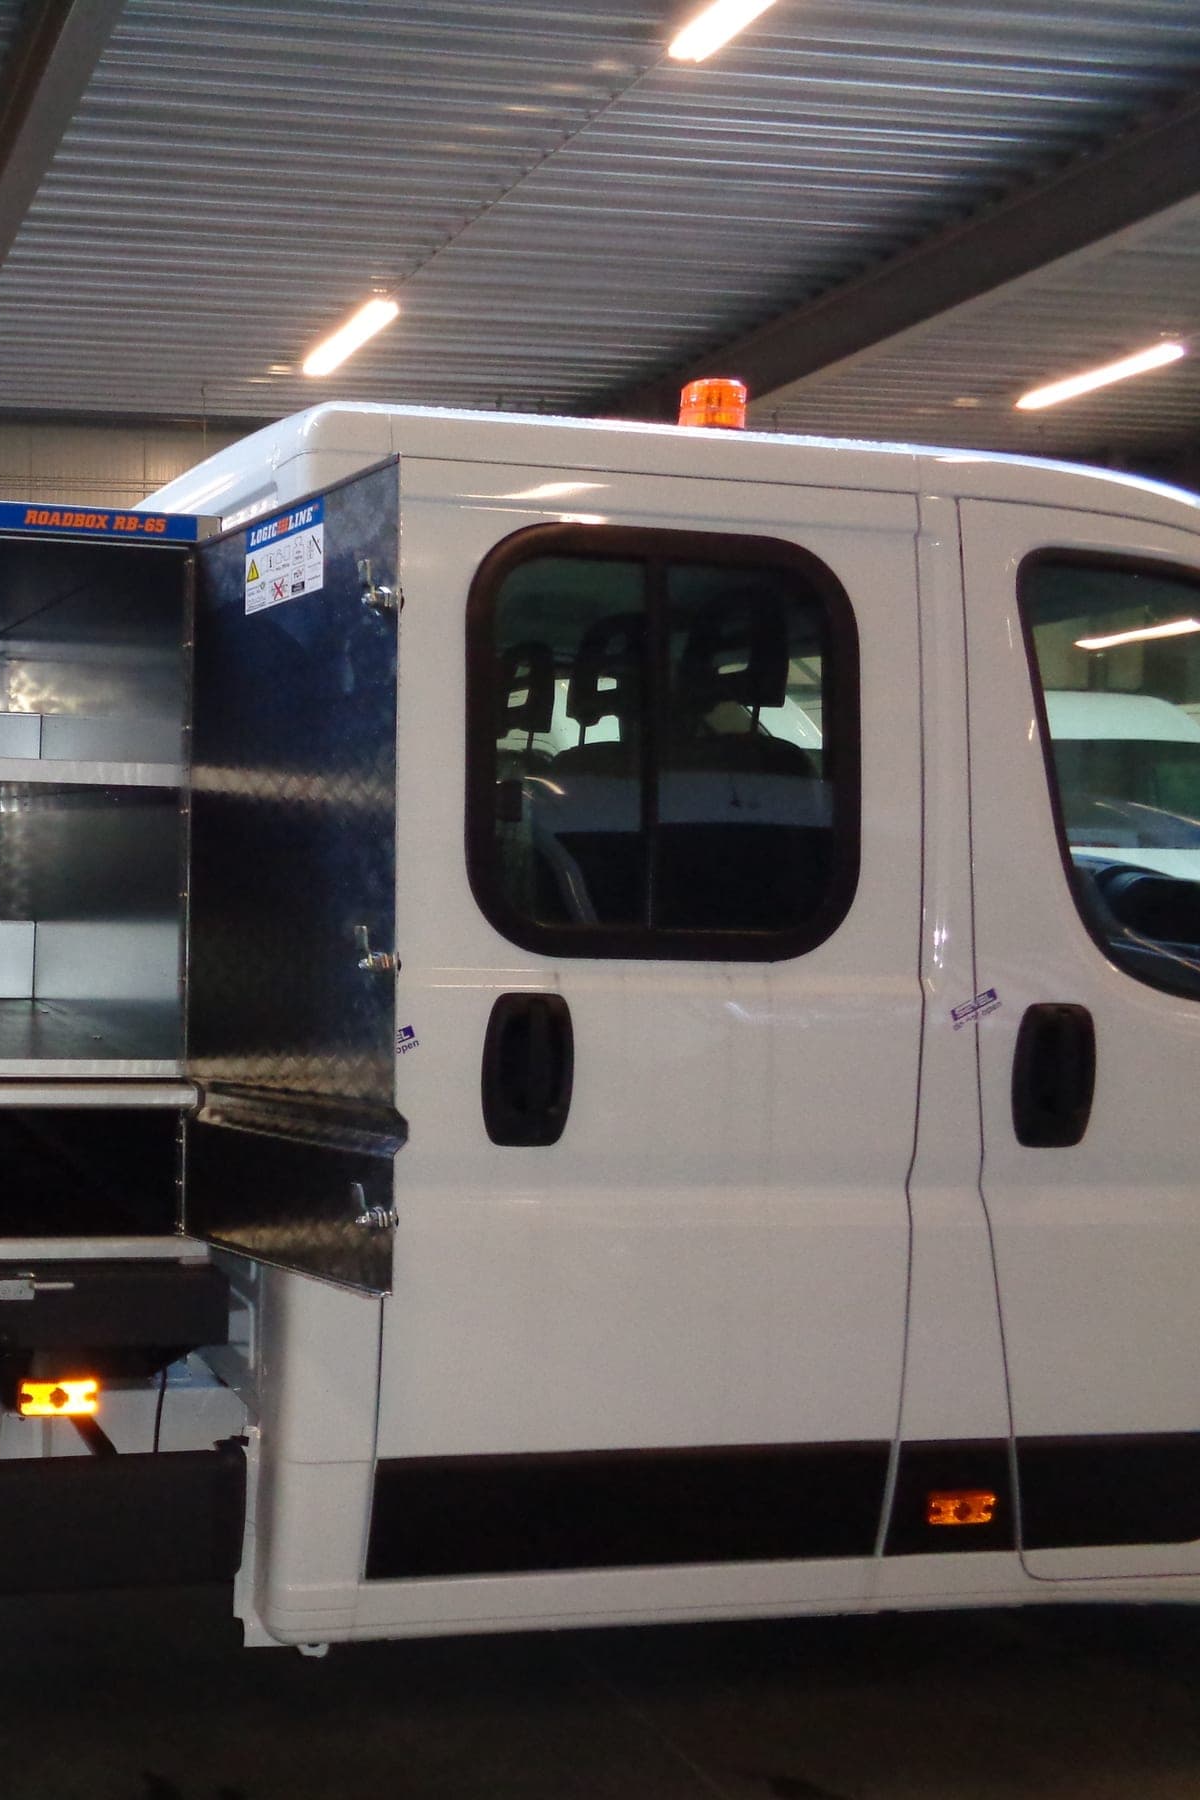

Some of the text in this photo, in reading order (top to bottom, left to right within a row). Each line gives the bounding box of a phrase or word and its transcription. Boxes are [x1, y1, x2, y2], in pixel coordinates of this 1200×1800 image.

[25, 509, 167, 533] ROADBOX RB-65
[250, 505, 314, 547] LOGIC LINE
